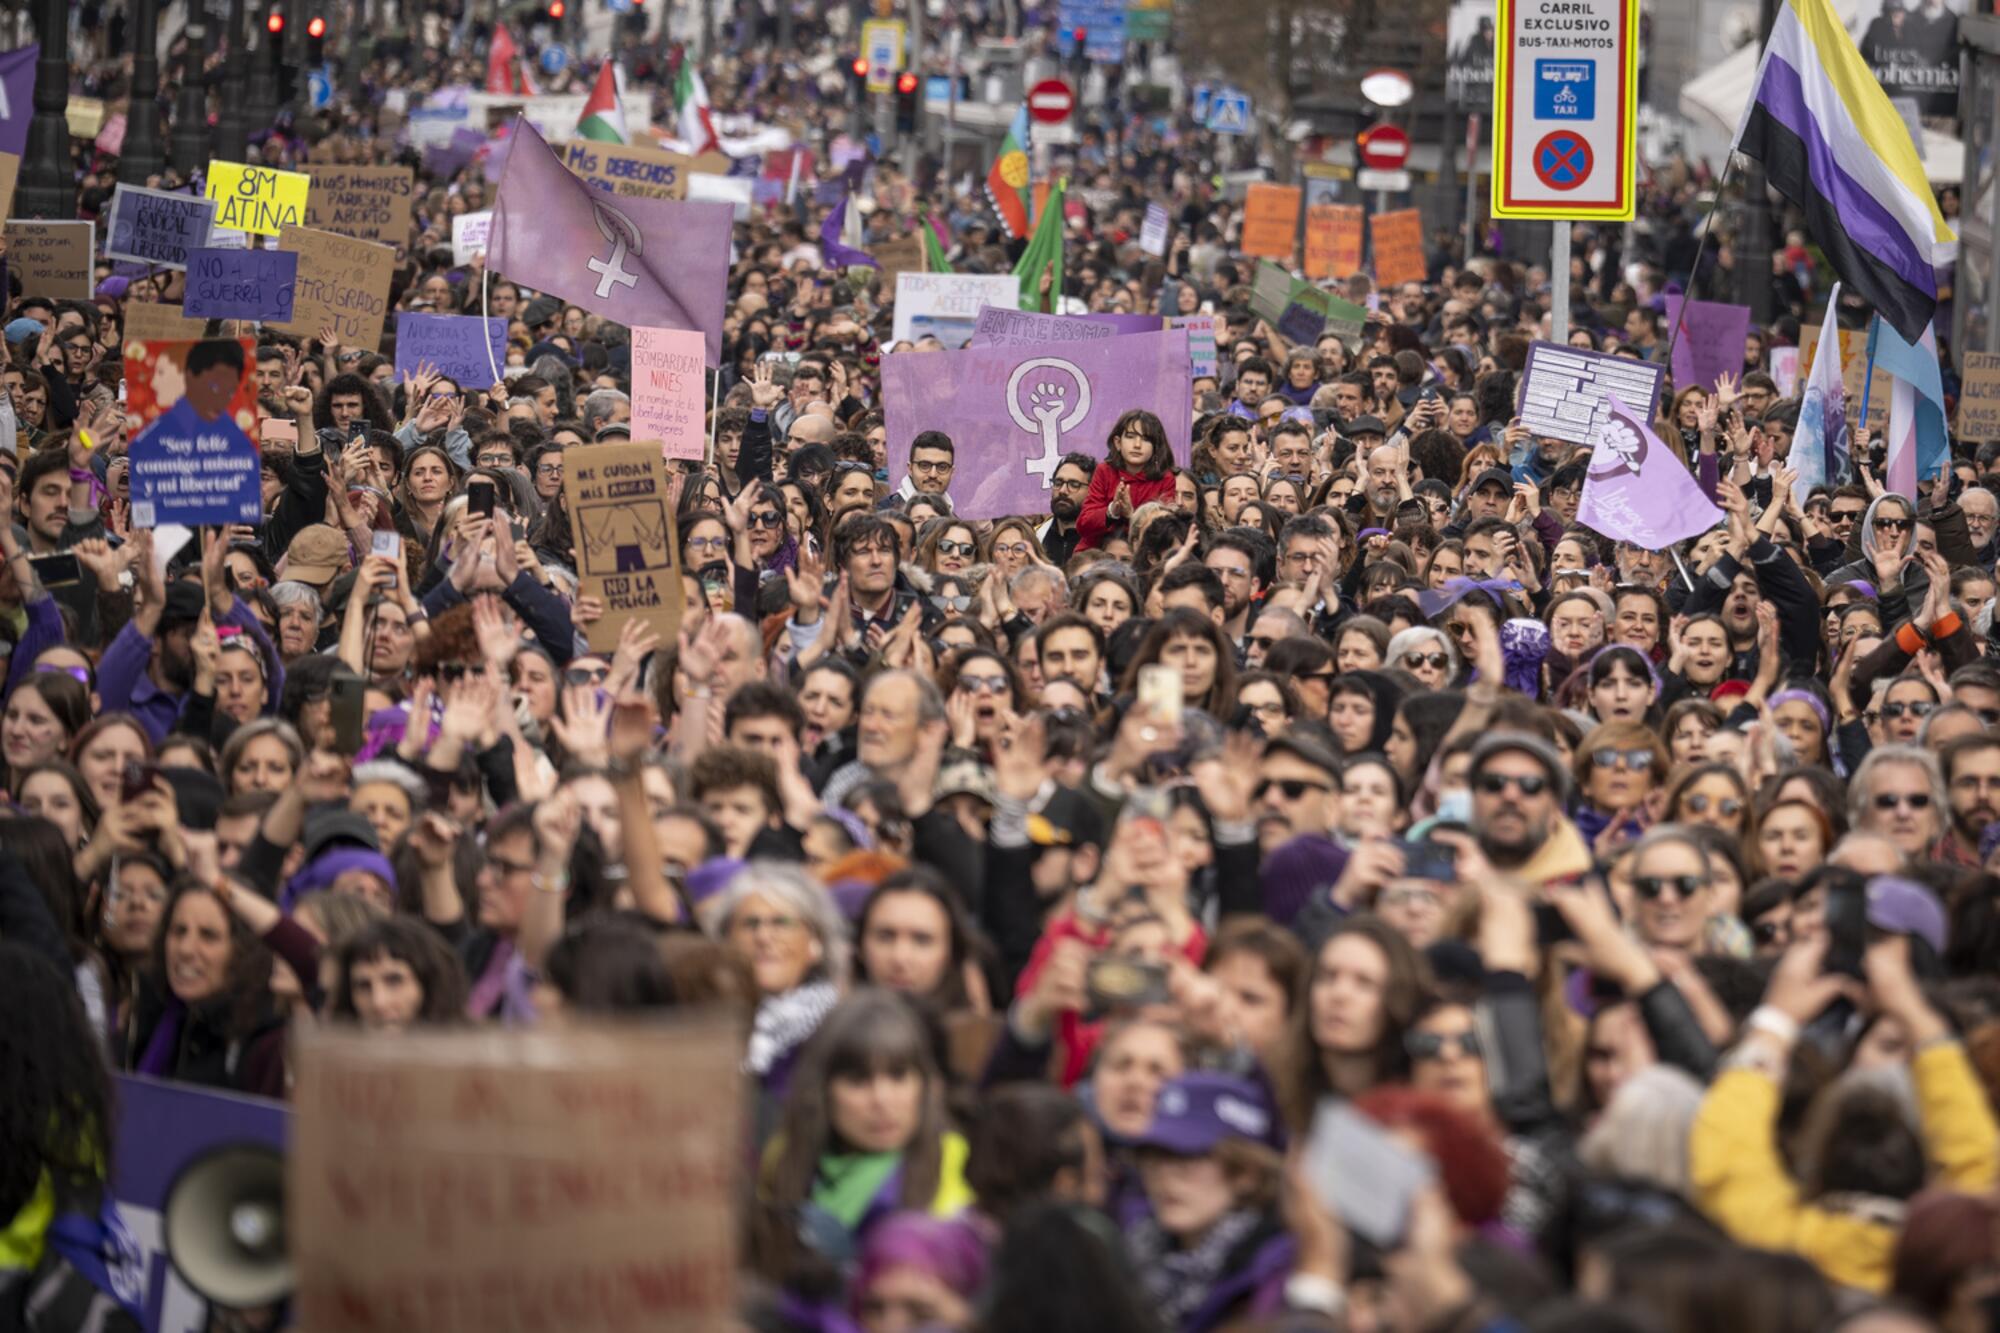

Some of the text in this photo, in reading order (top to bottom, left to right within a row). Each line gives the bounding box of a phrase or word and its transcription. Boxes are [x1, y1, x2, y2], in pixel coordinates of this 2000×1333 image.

[1540, 3, 1594, 14] CARRIL
[1524, 19, 1610, 30] EXCLUSIVO
[1519, 37, 1613, 48] BUS-TAXI-MOTOS
[1553, 105, 1577, 114] TAXI
[238, 168, 277, 198] 8M
[210, 184, 298, 230] LATINA
[198, 258, 224, 280] NO
[198, 280, 262, 304] GUERRA
[980, 310, 1050, 339] ENTRE
[633, 350, 704, 375] BOMBARDEAN
[603, 462, 652, 478] CUIDAN
[604, 577, 654, 596] NO LA
